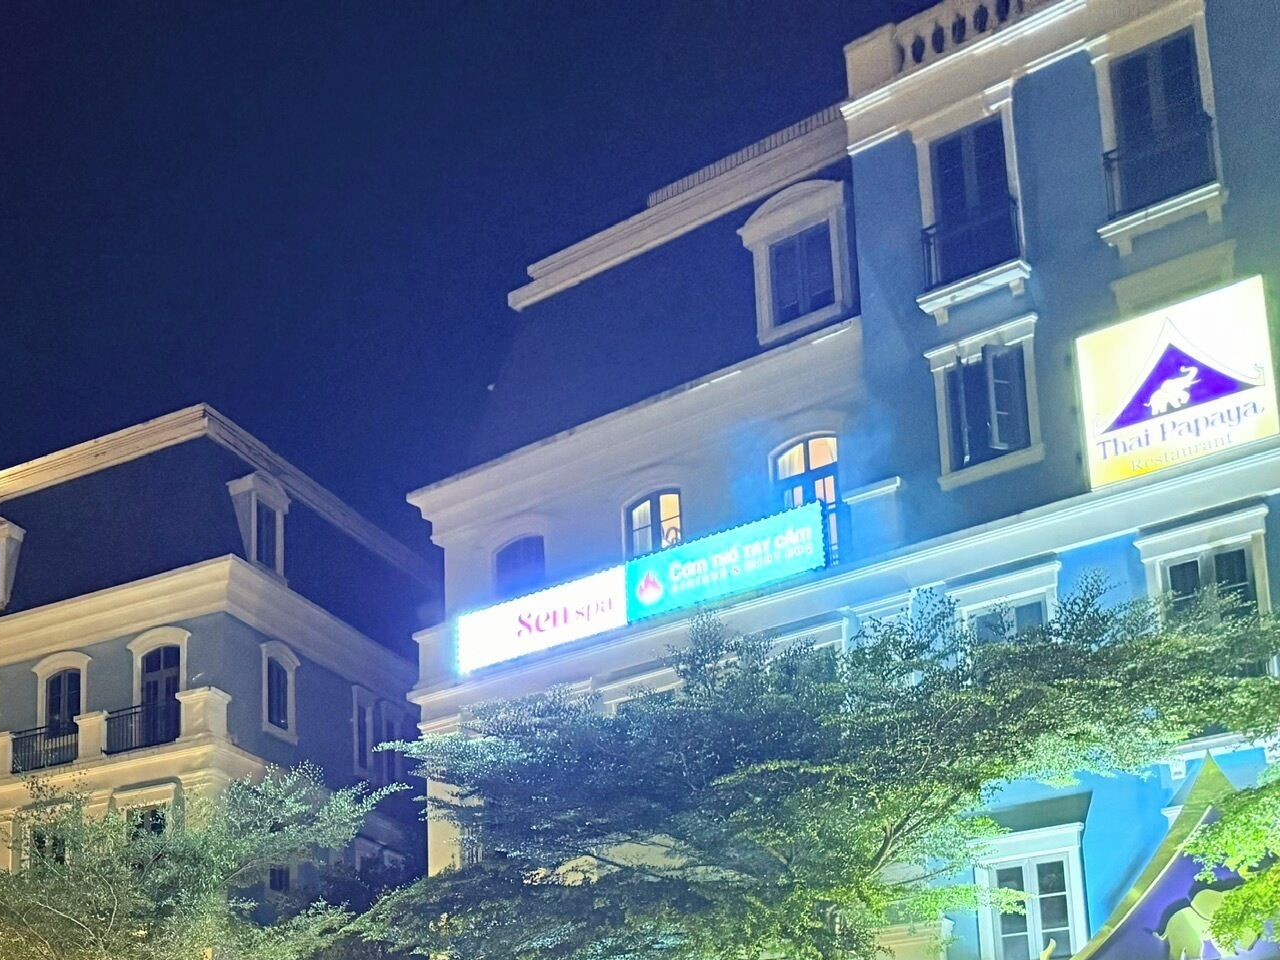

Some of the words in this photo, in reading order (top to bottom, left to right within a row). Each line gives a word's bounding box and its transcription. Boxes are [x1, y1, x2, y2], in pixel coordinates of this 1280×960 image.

[1096, 428, 1151, 460] Thai
[1159, 401, 1265, 442] Papaya
[1131, 433, 1233, 472] Restaurant
[518, 606, 568, 637] Sen
[575, 597, 612, 622] spa
